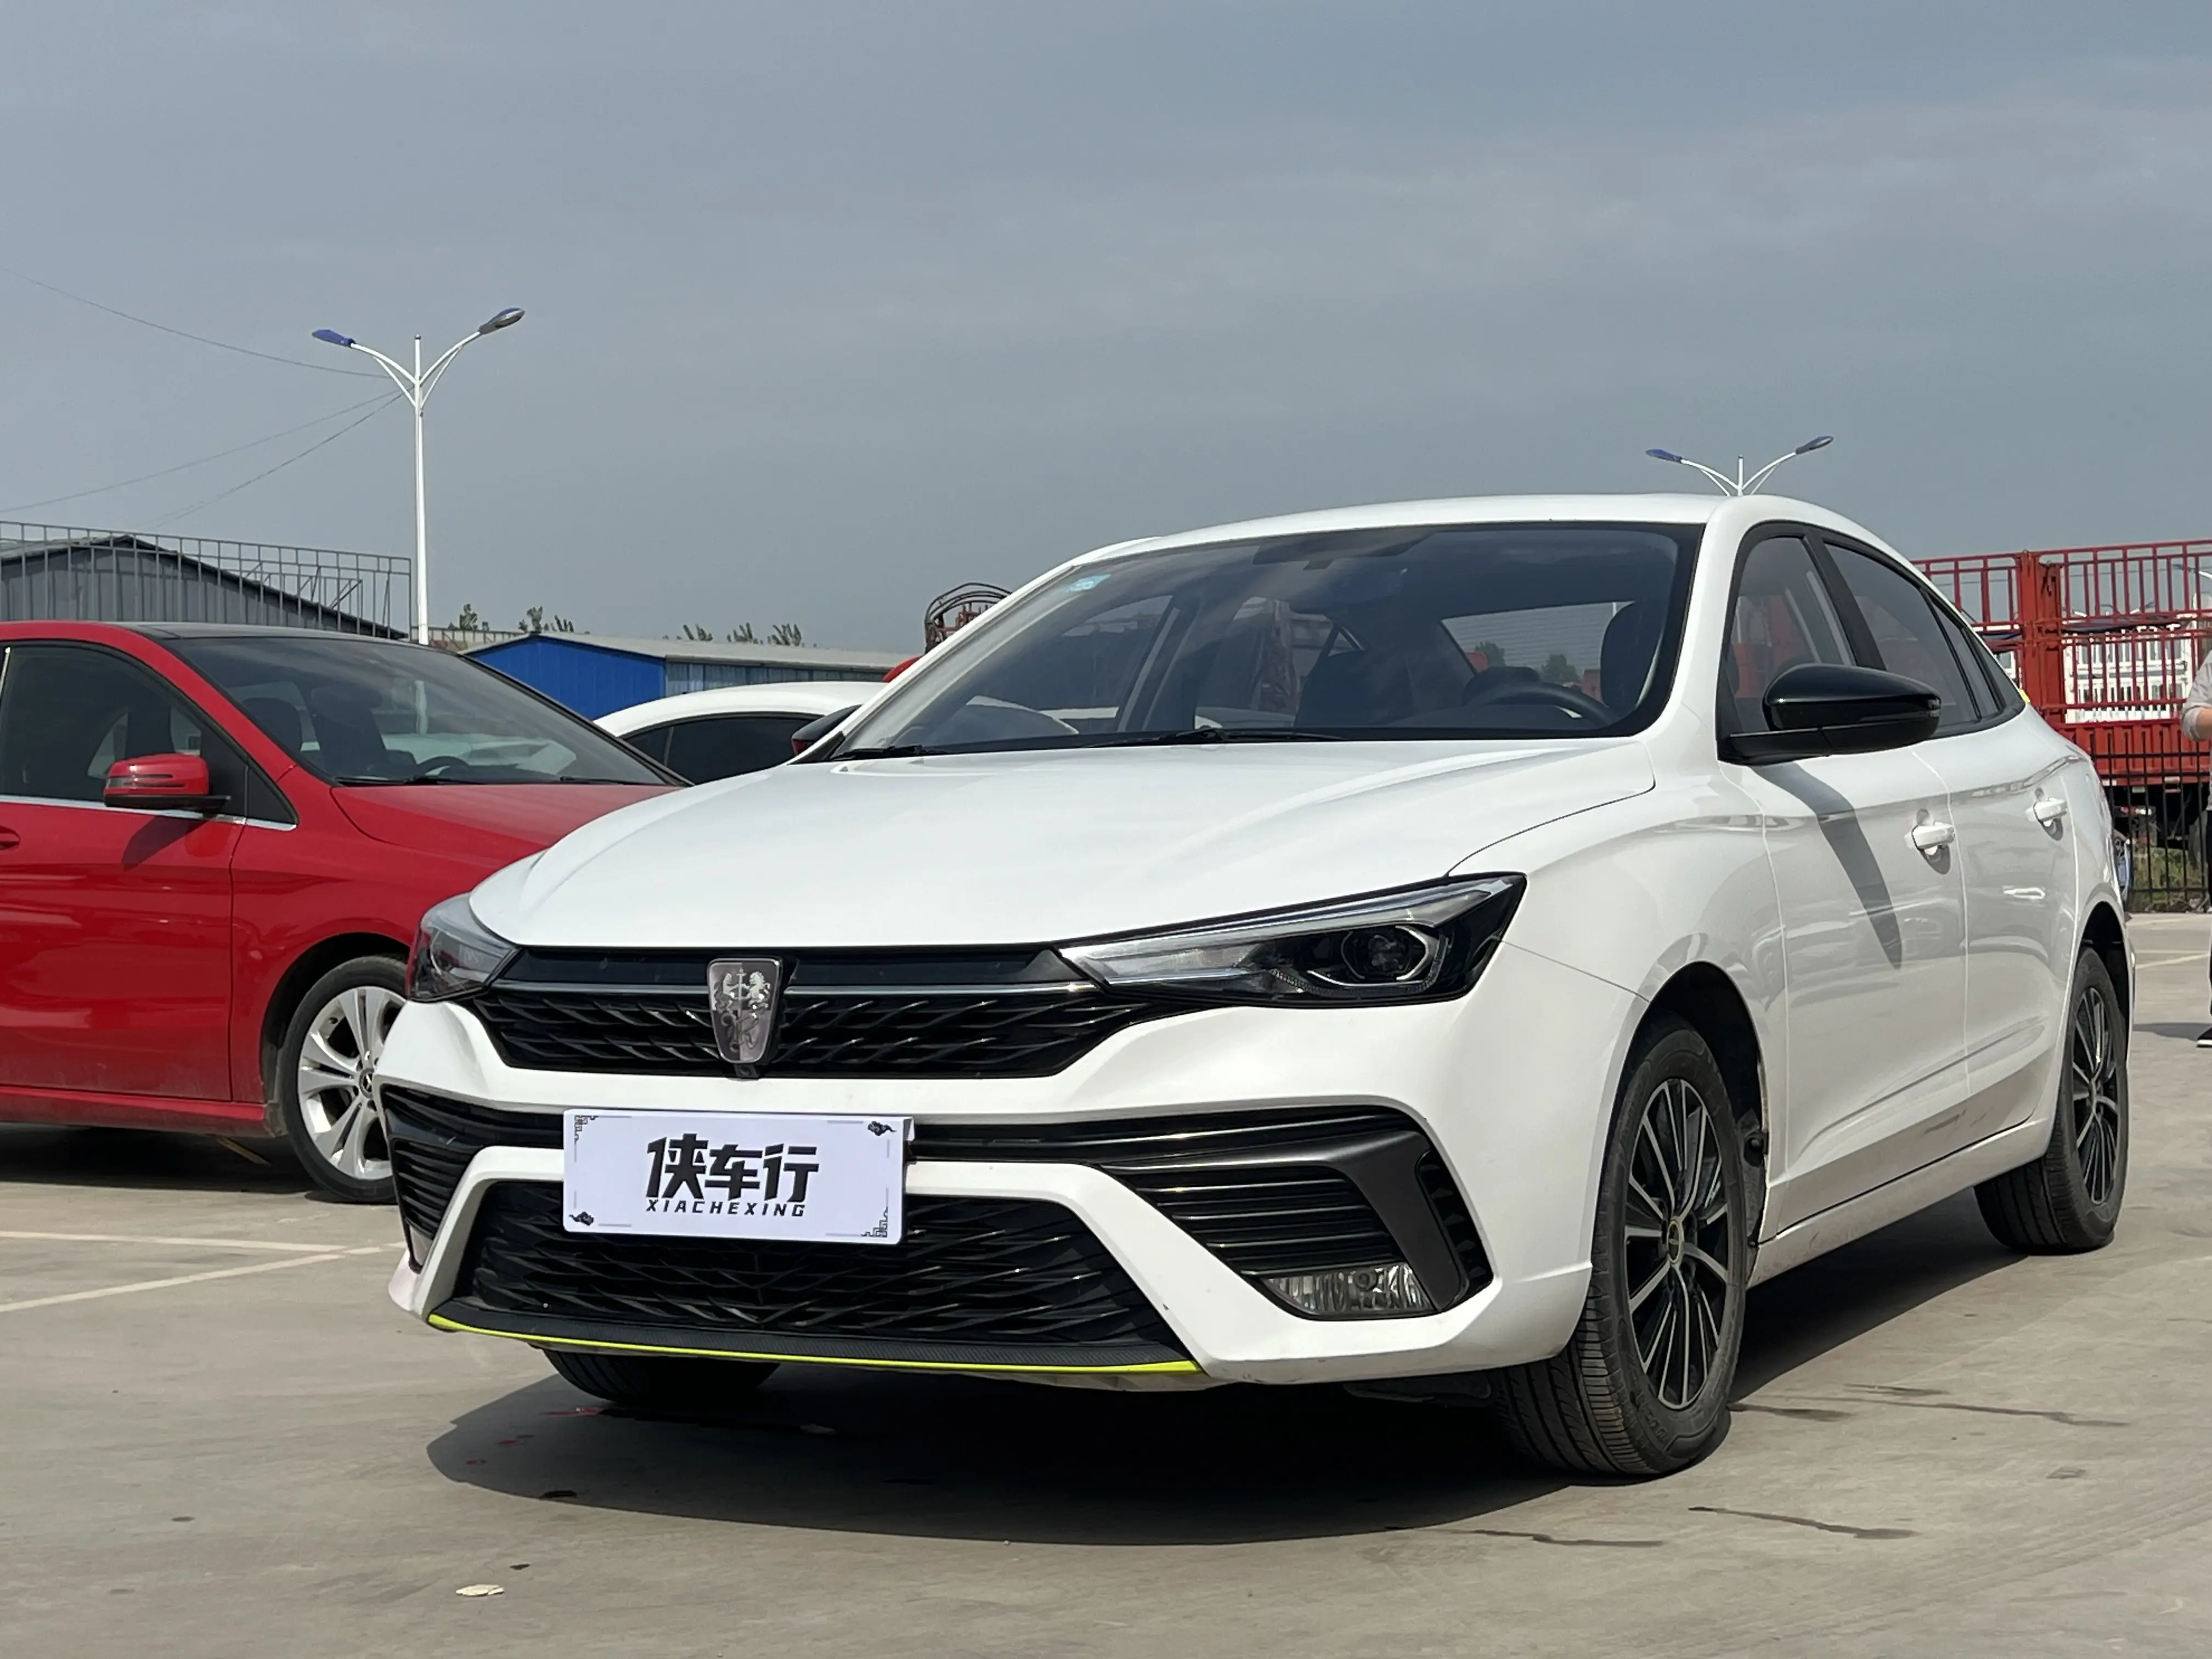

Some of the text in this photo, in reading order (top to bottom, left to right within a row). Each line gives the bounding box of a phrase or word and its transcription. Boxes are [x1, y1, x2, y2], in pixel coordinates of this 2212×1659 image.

[646, 1133, 820, 1204] 侠车行
[646, 1199, 806, 1217] XIACHEXING
